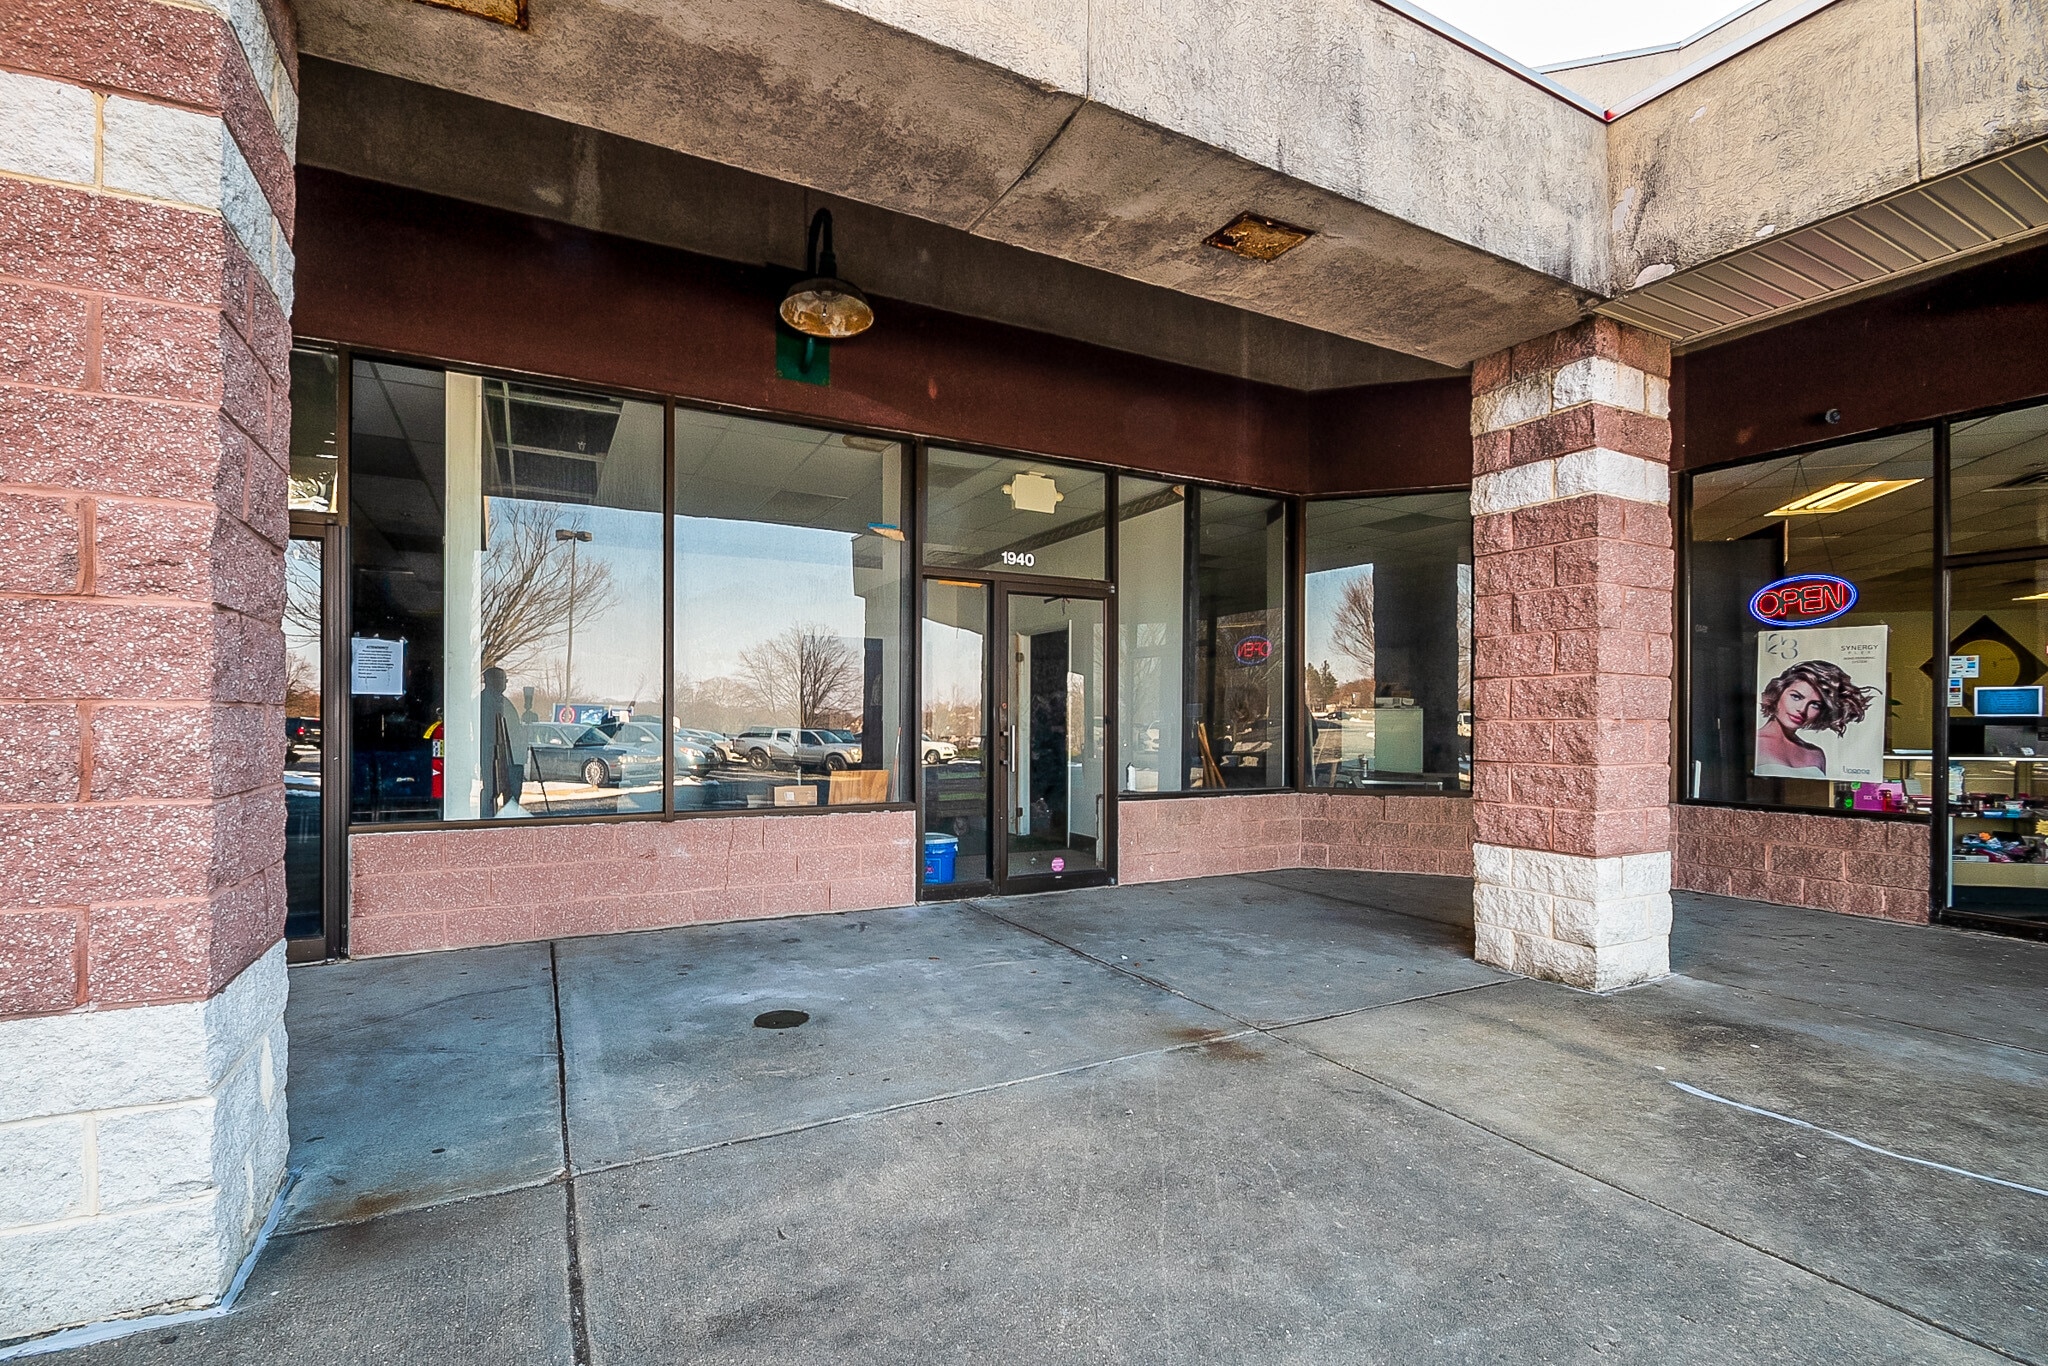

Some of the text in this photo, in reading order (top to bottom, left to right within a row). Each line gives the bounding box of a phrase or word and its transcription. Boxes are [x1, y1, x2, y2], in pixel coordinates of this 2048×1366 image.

[1001, 551, 1035, 567] 1940
[1756, 582, 1844, 617] OPEN
[1840, 644, 1879, 652] SYNERGY
